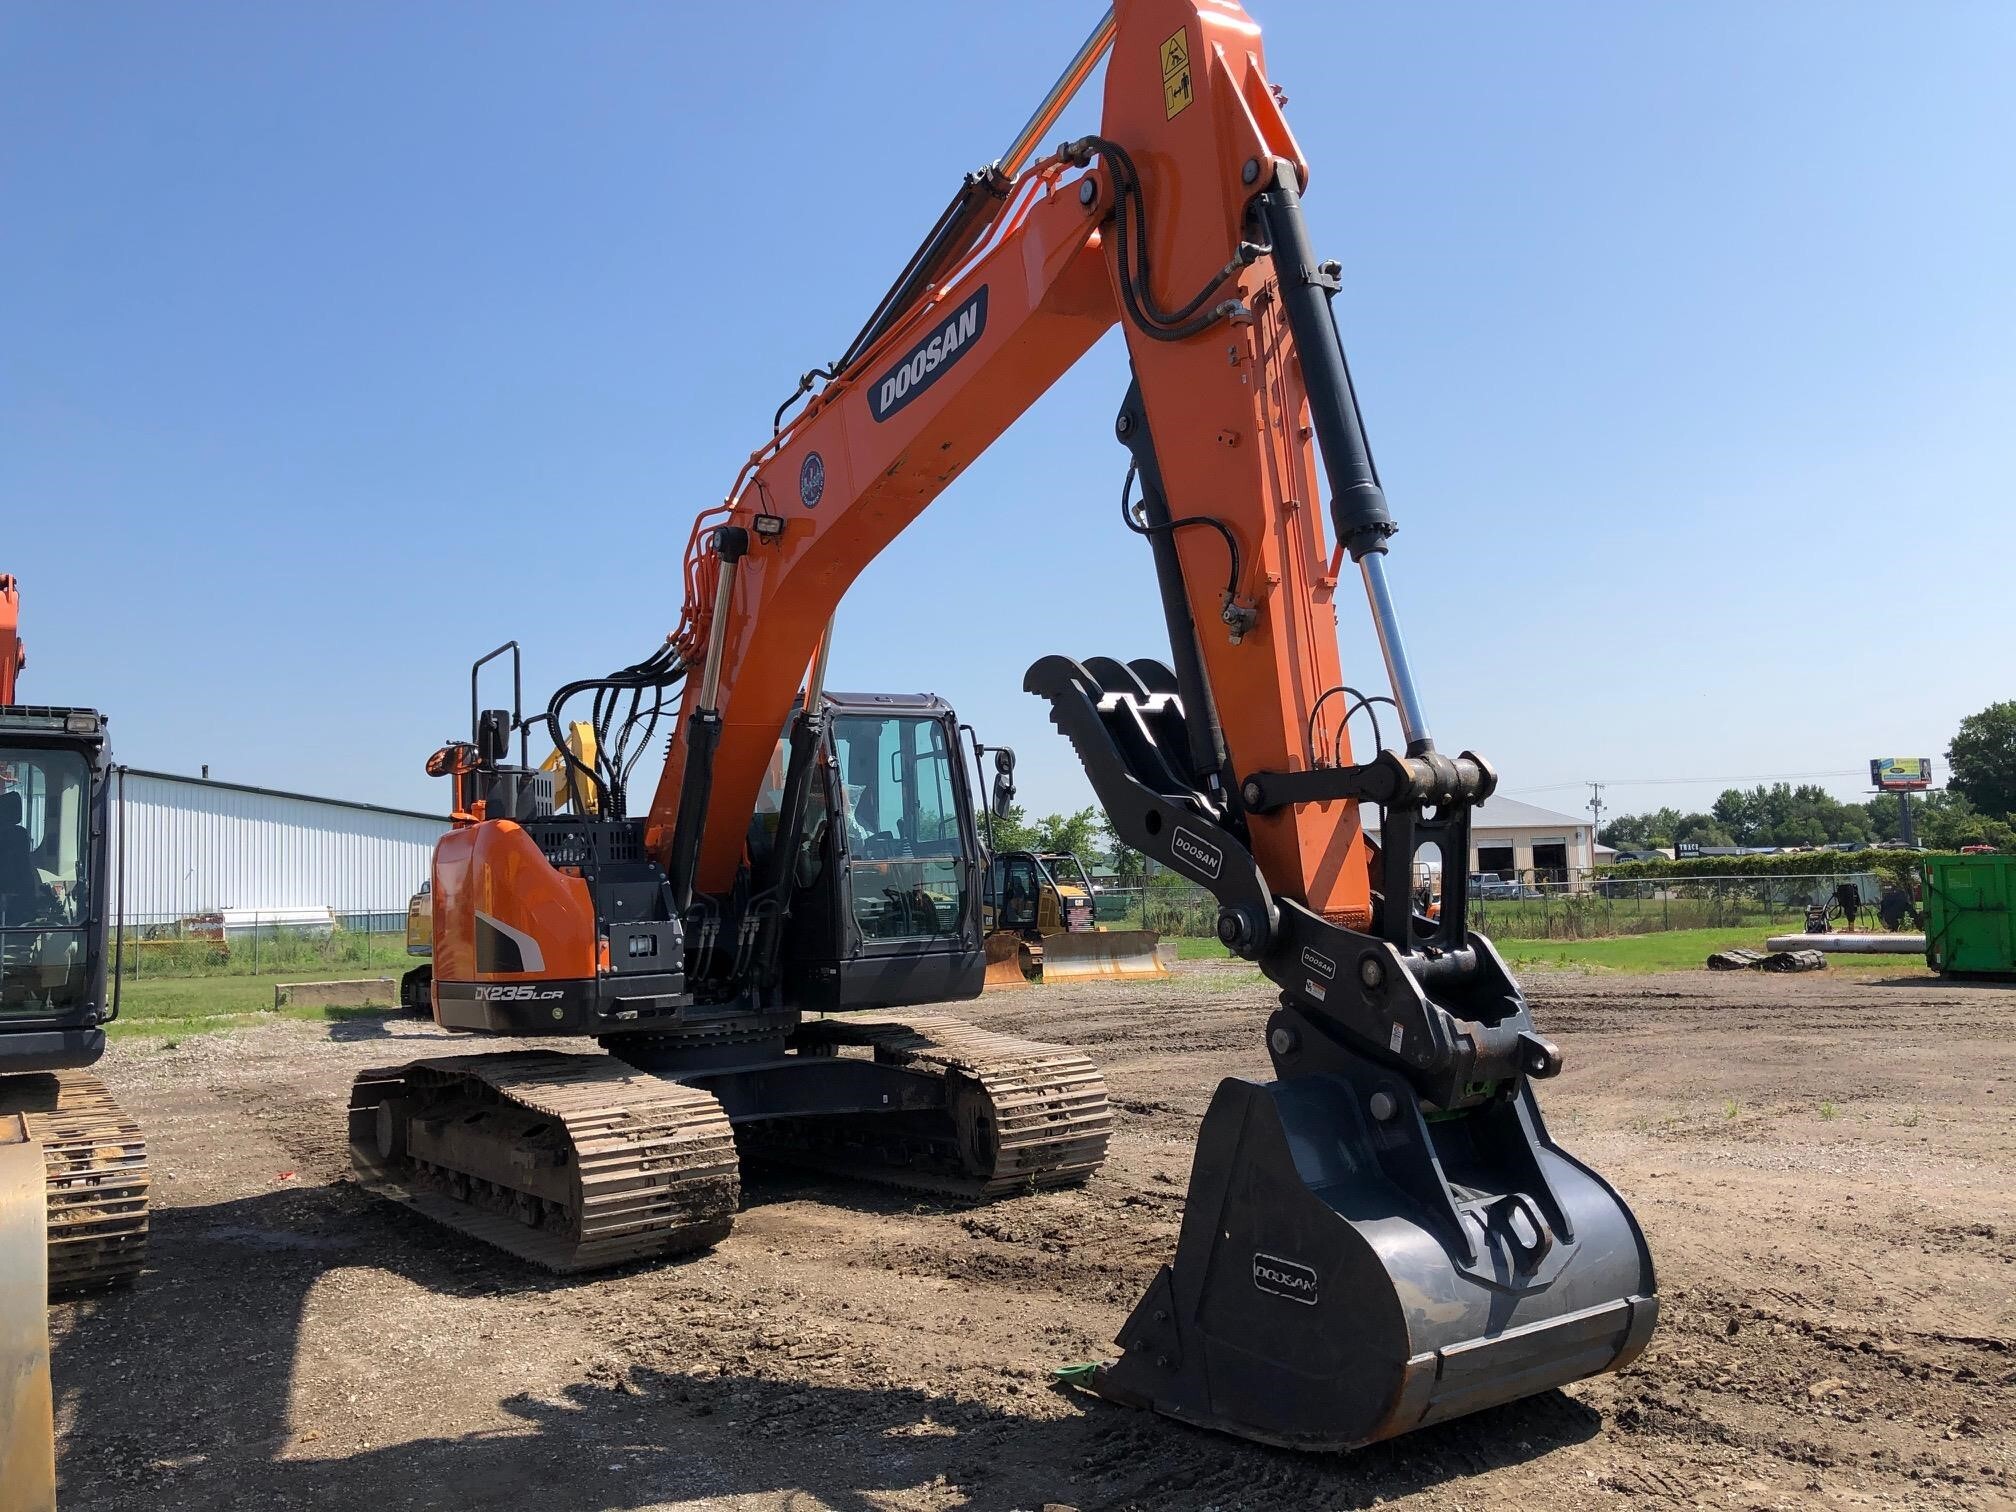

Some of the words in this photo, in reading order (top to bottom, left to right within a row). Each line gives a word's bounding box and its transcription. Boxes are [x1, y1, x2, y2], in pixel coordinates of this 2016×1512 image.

[880, 301, 978, 414] DOOSAN
[1175, 837, 1218, 868] DOOSAN
[1304, 953, 1333, 973] DOOSAN
[1255, 1265, 1317, 1292] DOOSAN
